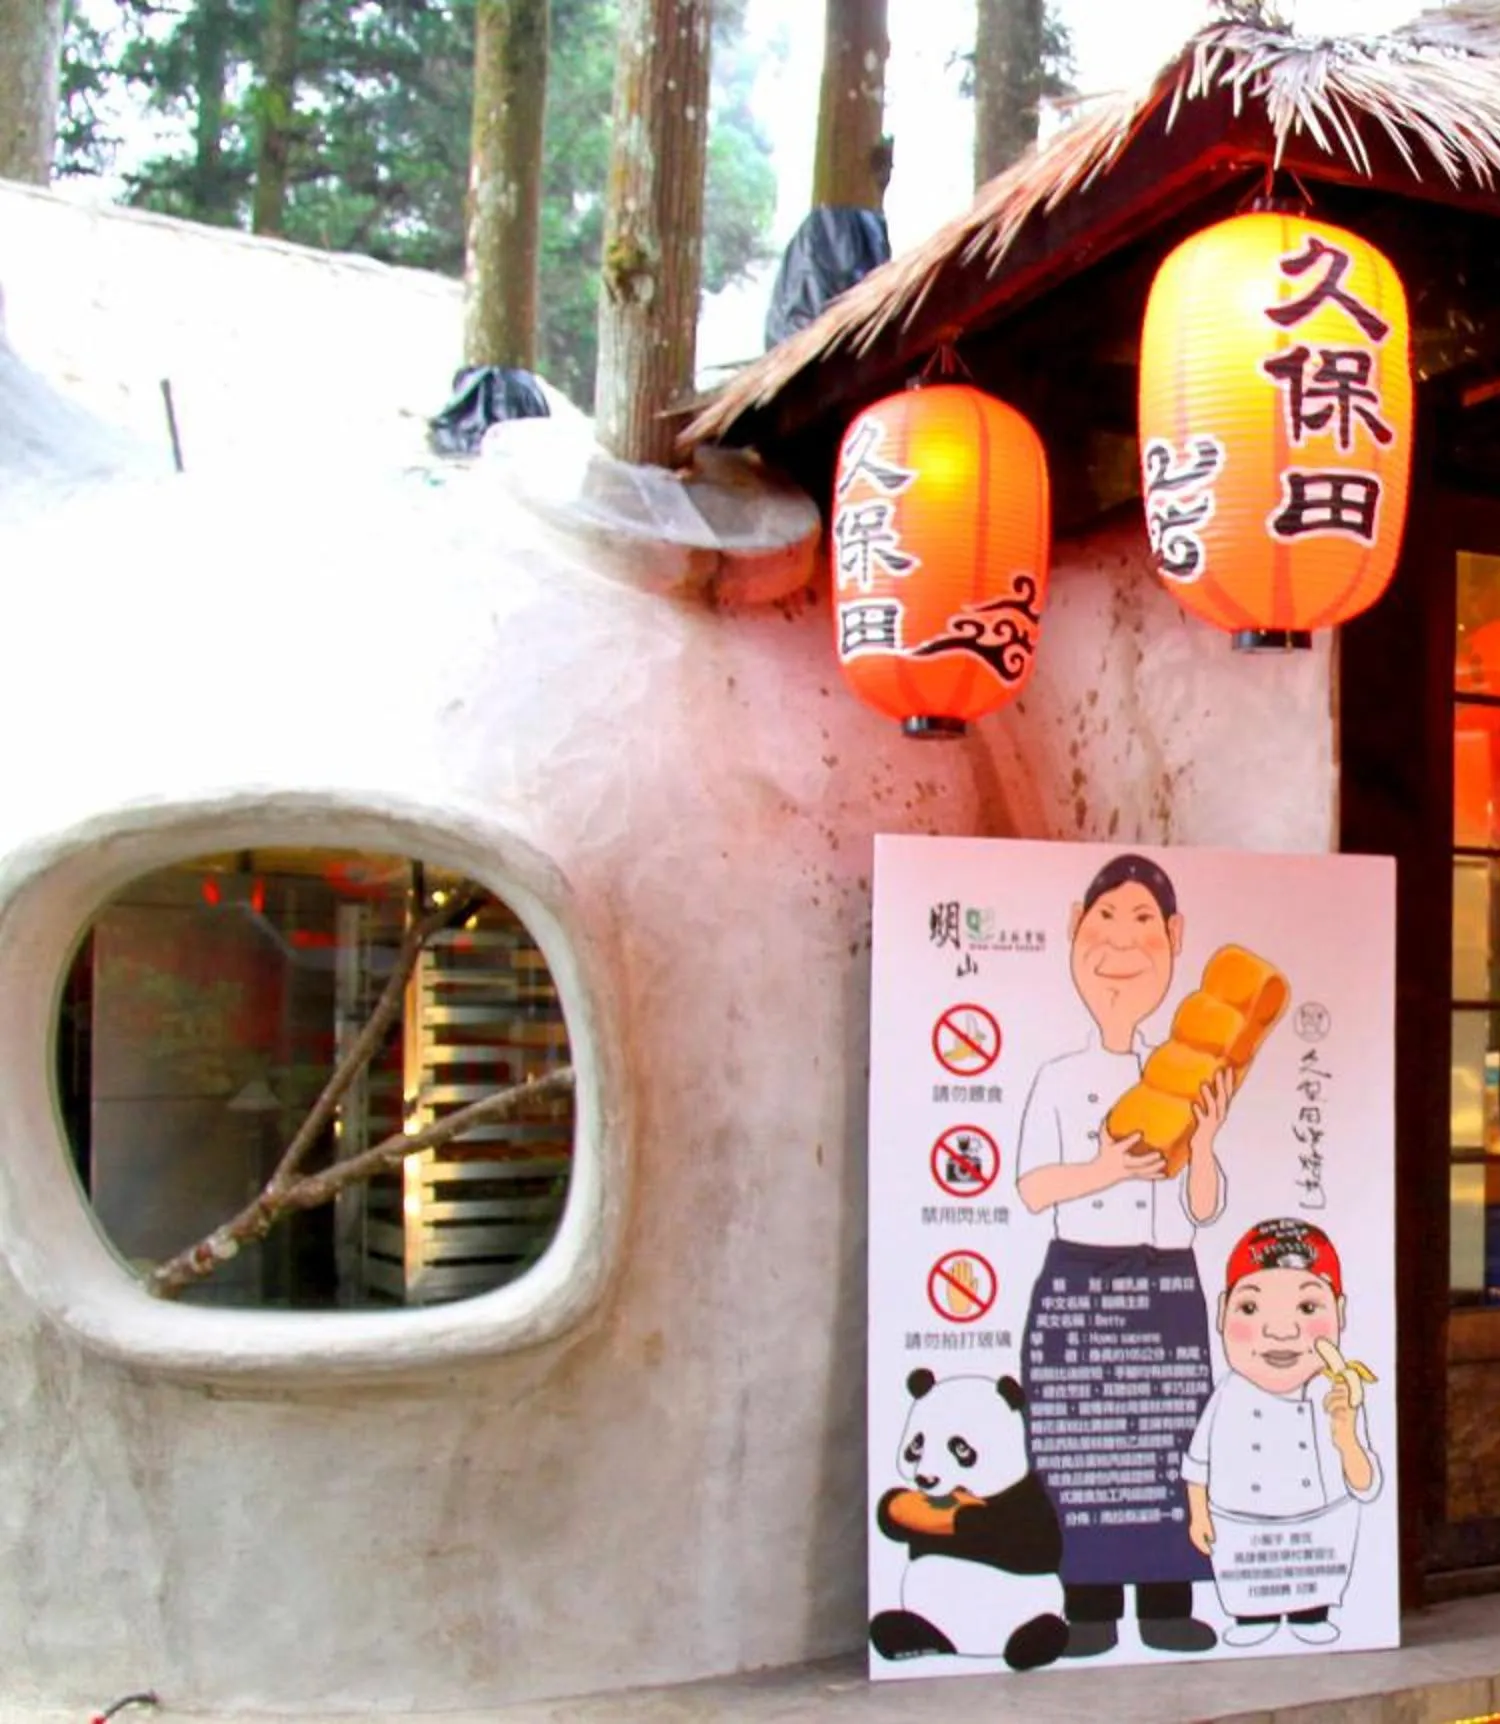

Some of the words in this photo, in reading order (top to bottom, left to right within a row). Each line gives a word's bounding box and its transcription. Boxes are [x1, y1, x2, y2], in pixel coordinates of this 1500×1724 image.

[1265, 237, 1394, 542] 久保田
[835, 418, 919, 662] 久保田
[921, 1207, 1010, 1225] 禁用閃光燈
[905, 1331, 1012, 1351] 請勿拍打玻璃
